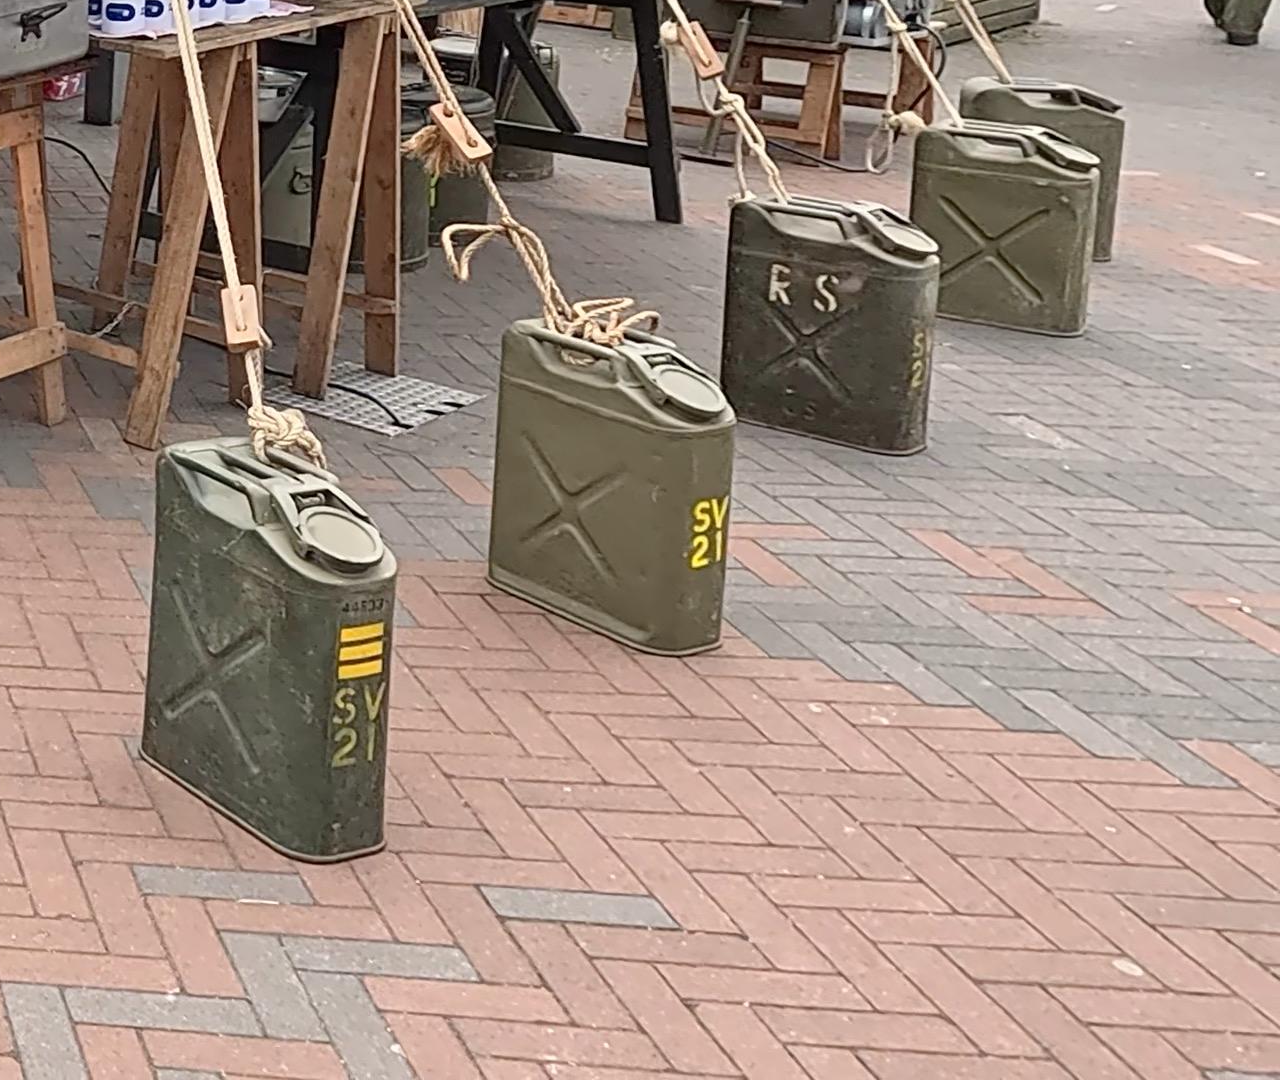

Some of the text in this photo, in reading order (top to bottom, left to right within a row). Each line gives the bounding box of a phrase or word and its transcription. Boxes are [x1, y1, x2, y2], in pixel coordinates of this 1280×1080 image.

[693, 495, 730, 533] SV
[691, 530, 723, 568] 21
[332, 681, 386, 725] SV
[331, 722, 377, 768] 21
